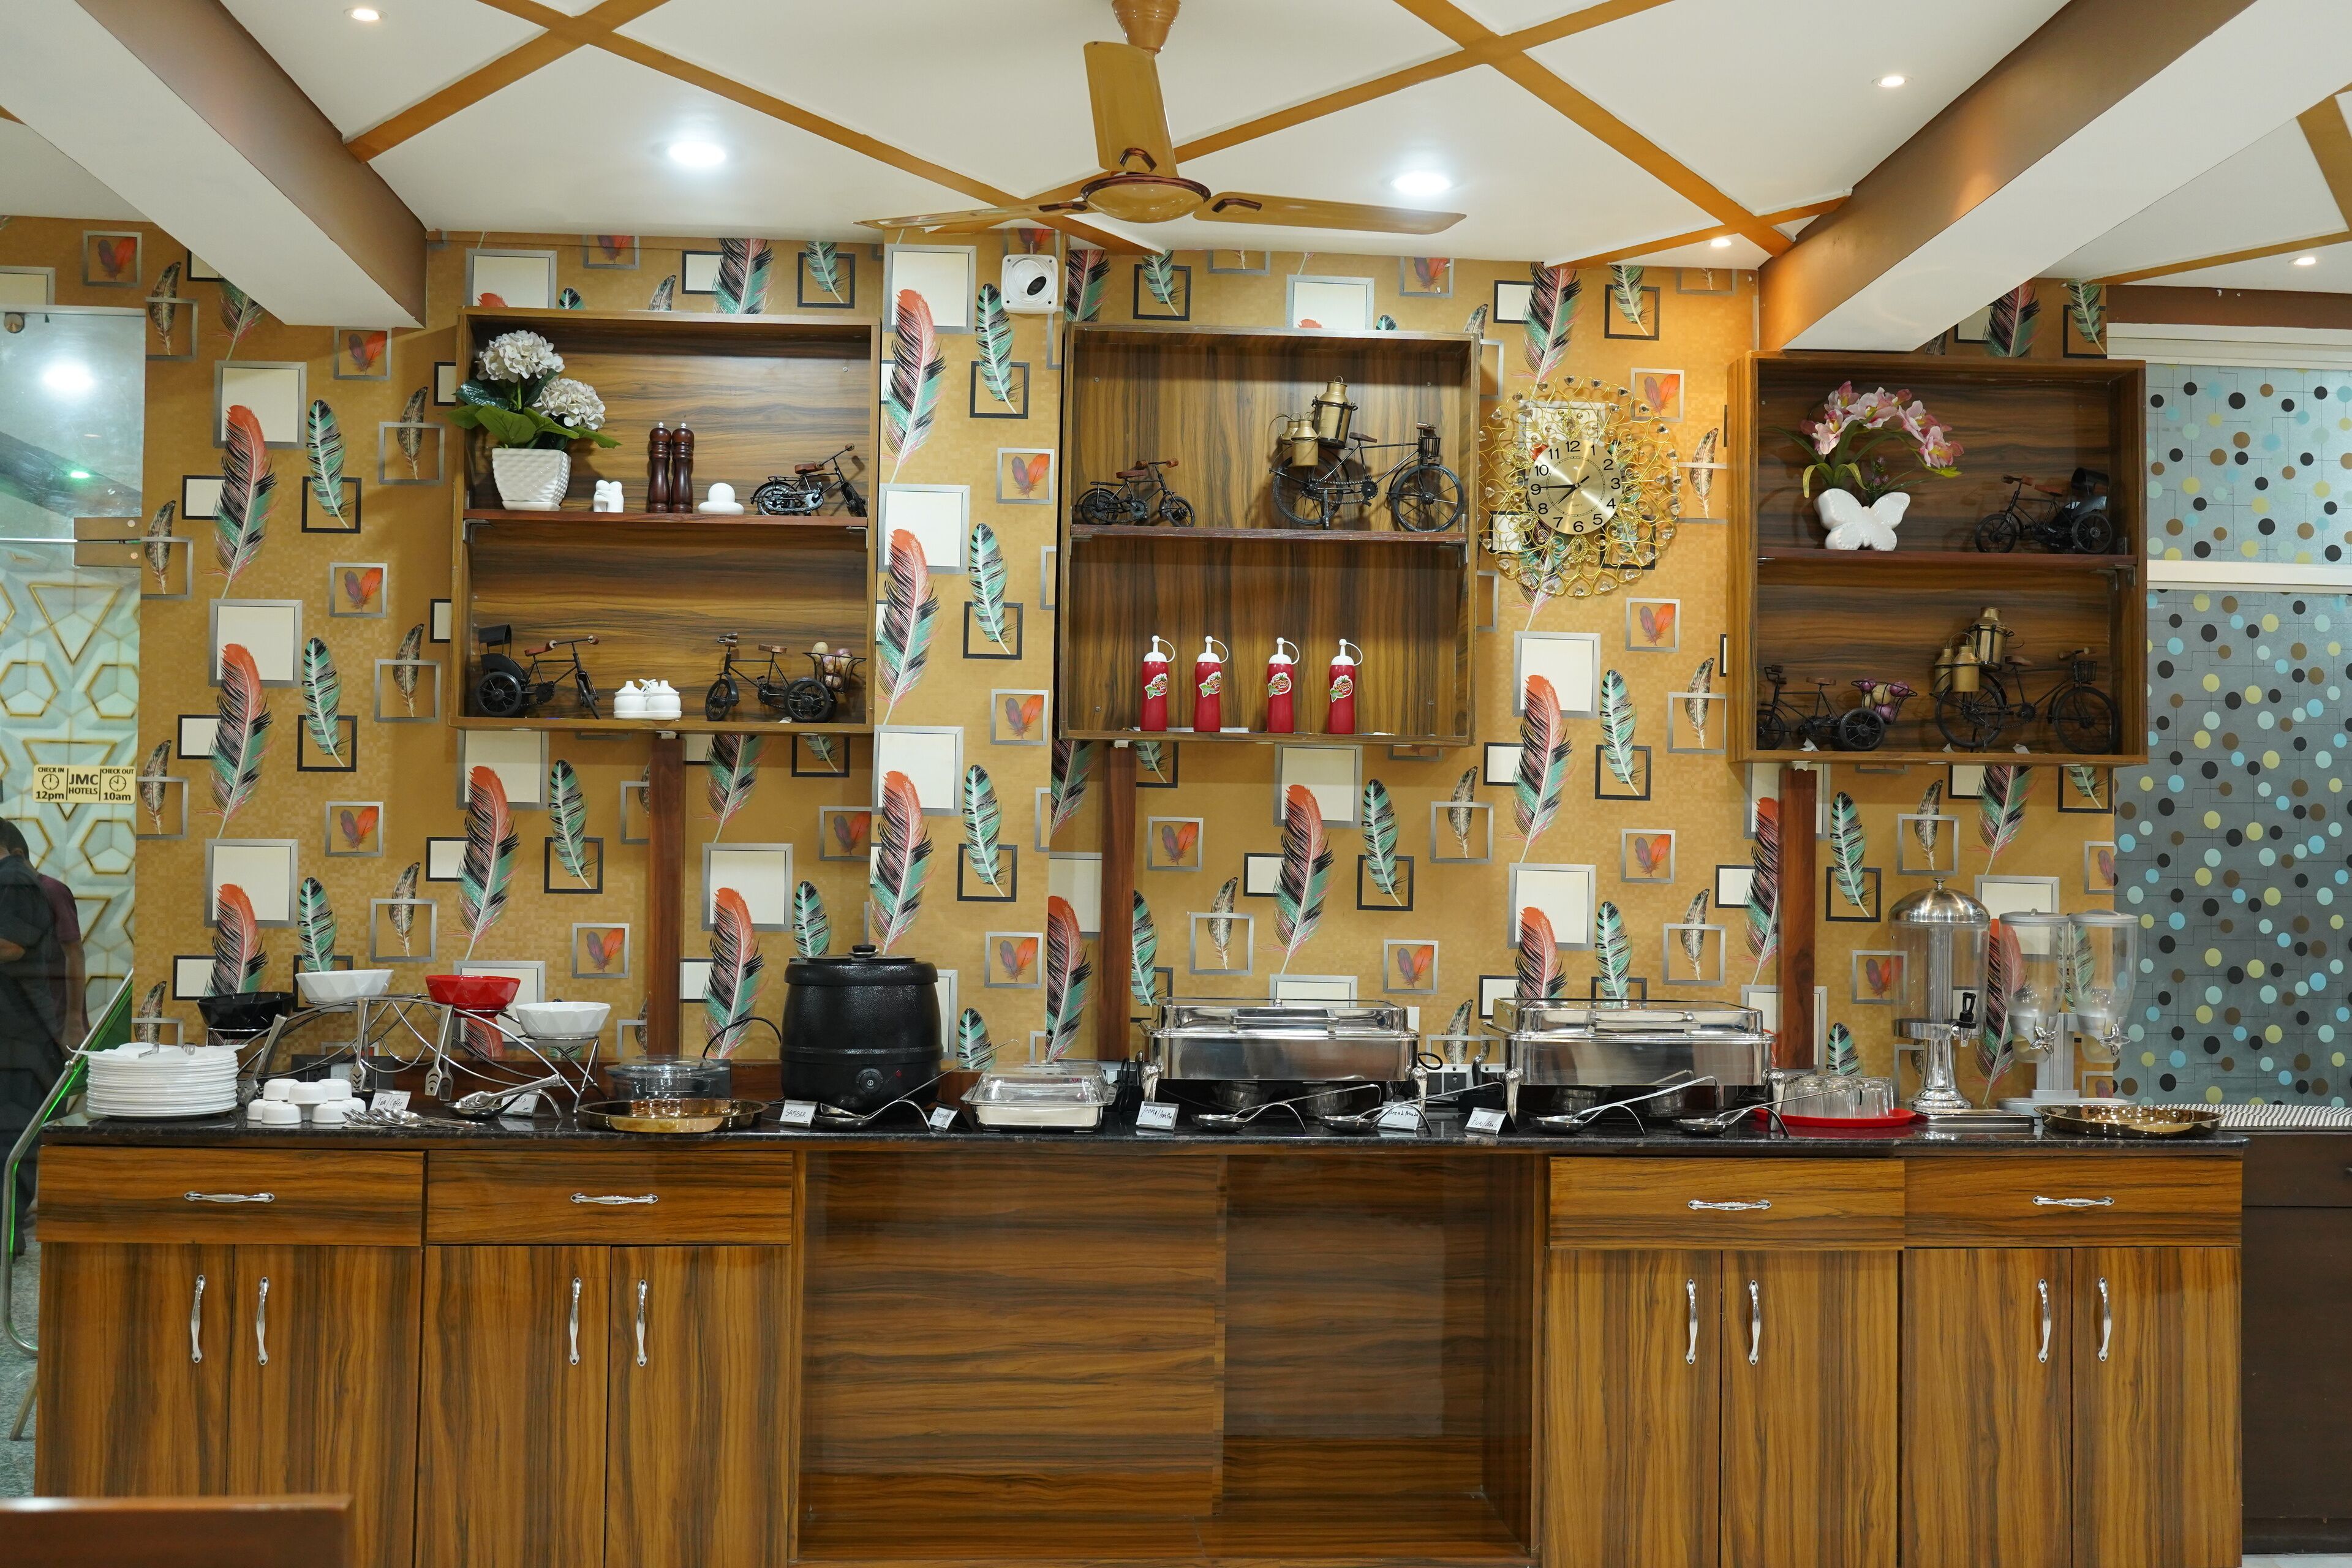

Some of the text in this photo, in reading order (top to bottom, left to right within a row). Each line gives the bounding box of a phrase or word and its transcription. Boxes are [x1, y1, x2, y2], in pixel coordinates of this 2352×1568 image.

[1565, 440, 1581, 452] 12
[1591, 444, 1596, 456] 1
[1548, 448, 1560, 459] 11
[1534, 464, 1549, 476] 10
[1603, 459, 1614, 470] 2
[1610, 478, 1620, 489] 3
[1531, 484, 1541, 495] 9
[1538, 503, 1548, 514] 8
[1606, 498, 1616, 509] 4
[1553, 517, 1563, 528] 7
[1593, 513, 1603, 525] 5
[1574, 521, 1584, 532] 6
[69, 774, 99, 785] JMC
[36, 791, 64, 801] 12pm
[104, 792, 131, 801] 10am
